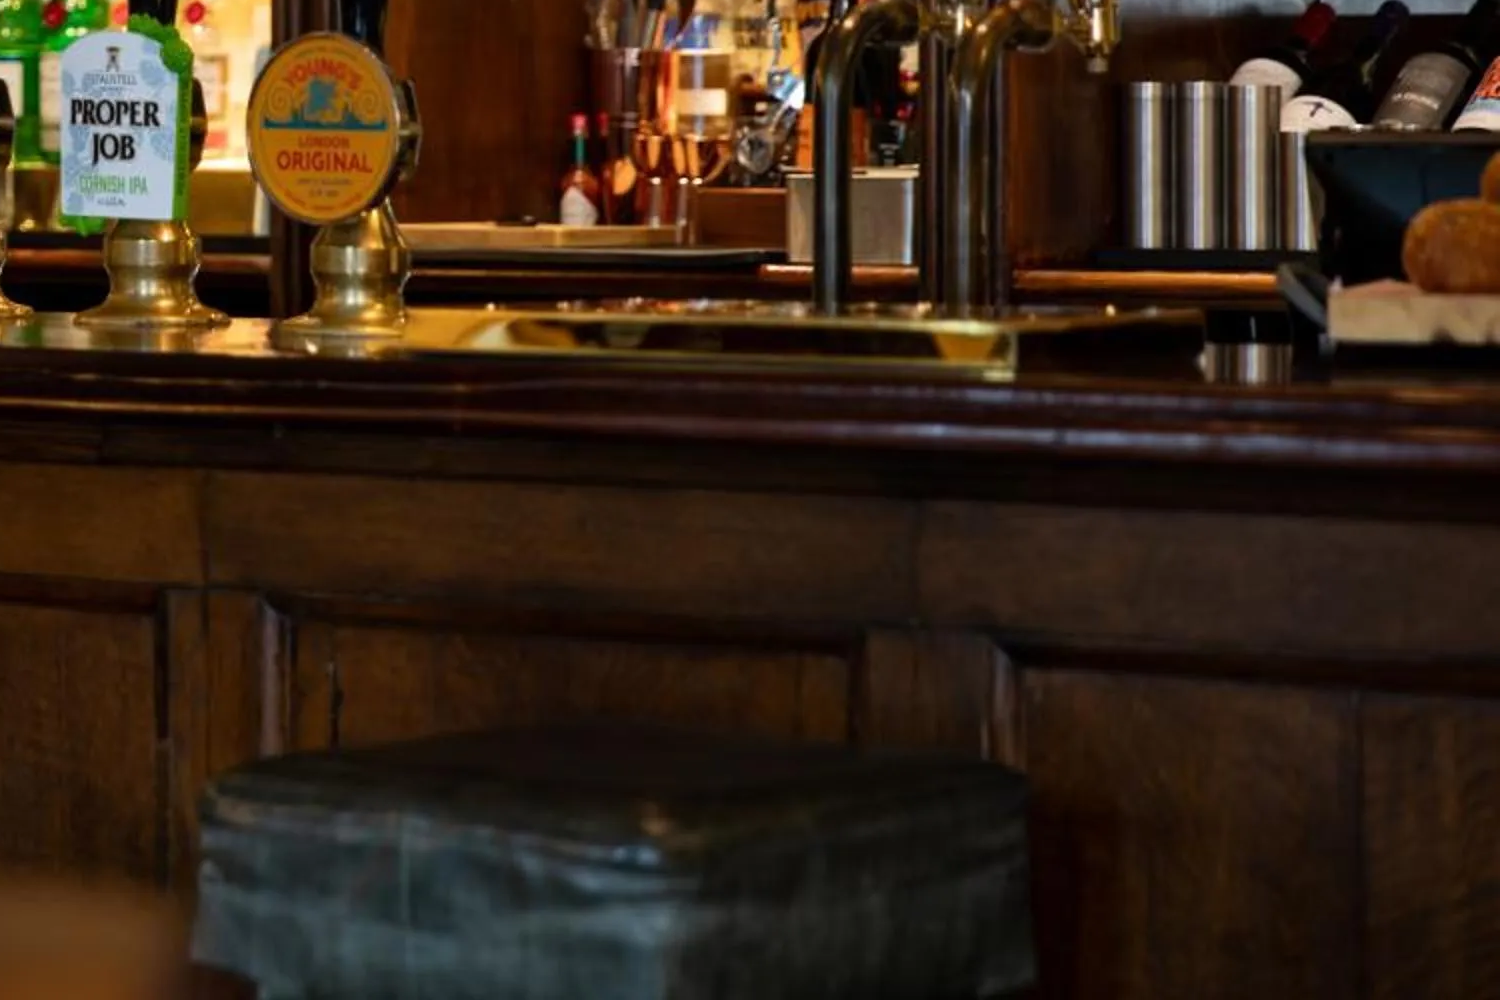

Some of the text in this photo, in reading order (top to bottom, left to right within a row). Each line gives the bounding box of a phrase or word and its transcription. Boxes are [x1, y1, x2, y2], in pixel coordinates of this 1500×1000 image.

[70, 99, 160, 127] PROPER
[92, 133, 135, 165] JOB
[276, 150, 373, 173] ORIGINAL
